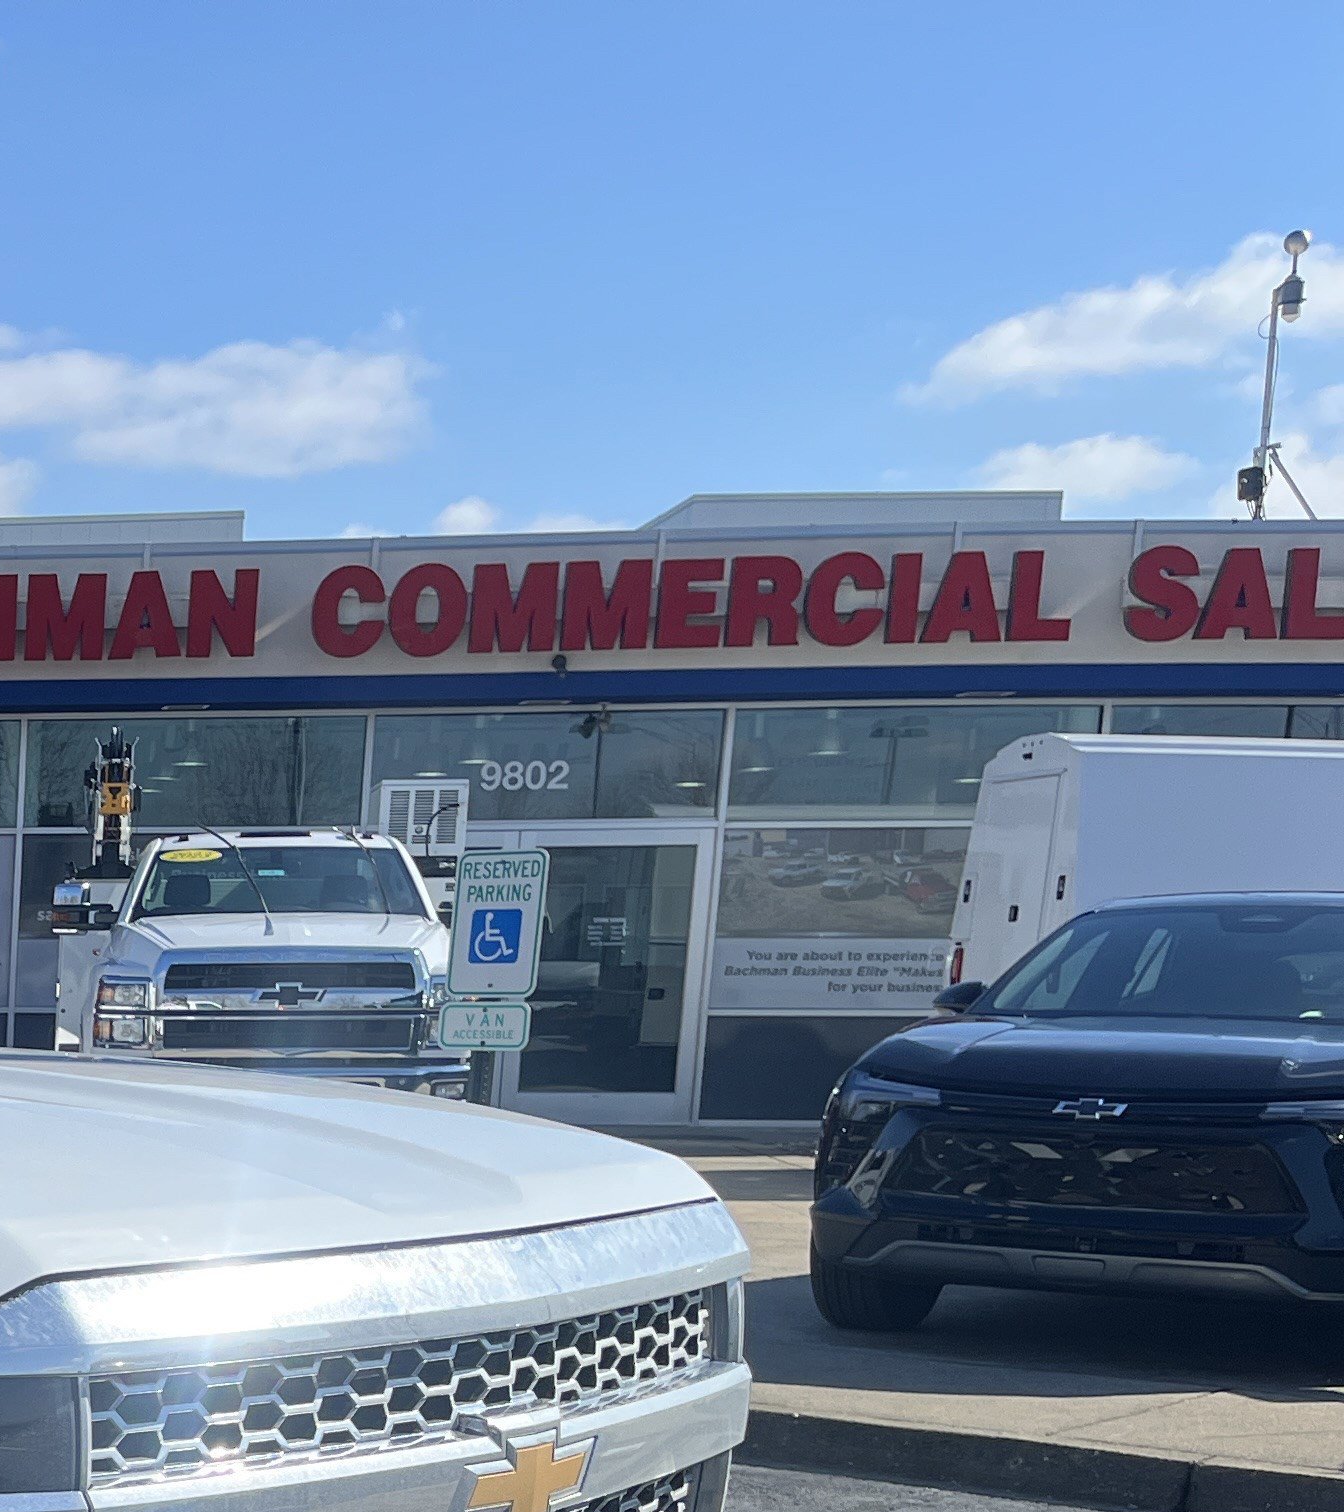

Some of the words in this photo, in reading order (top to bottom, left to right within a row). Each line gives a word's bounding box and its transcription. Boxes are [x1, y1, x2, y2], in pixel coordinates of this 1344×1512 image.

[312, 549, 1072, 657] COMMERCIAL
[1123, 545, 1344, 642] SAL
[480, 760, 570, 791] 9802
[463, 860, 541, 880] RESERVED
[467, 884, 532, 903] PARKING
[747, 950, 772, 961] You
[775, 952, 799, 961] are
[802, 950, 843, 961] about
[846, 951, 862, 961] to
[724, 965, 788, 977] Bachman
[792, 965, 852, 977] Business
[856, 965, 889, 977] Elite
[827, 980, 848, 992] for
[851, 982, 884, 994] your
[465, 1013, 505, 1027] VAN
[452, 1029, 514, 1040] ACCESSIBLE
